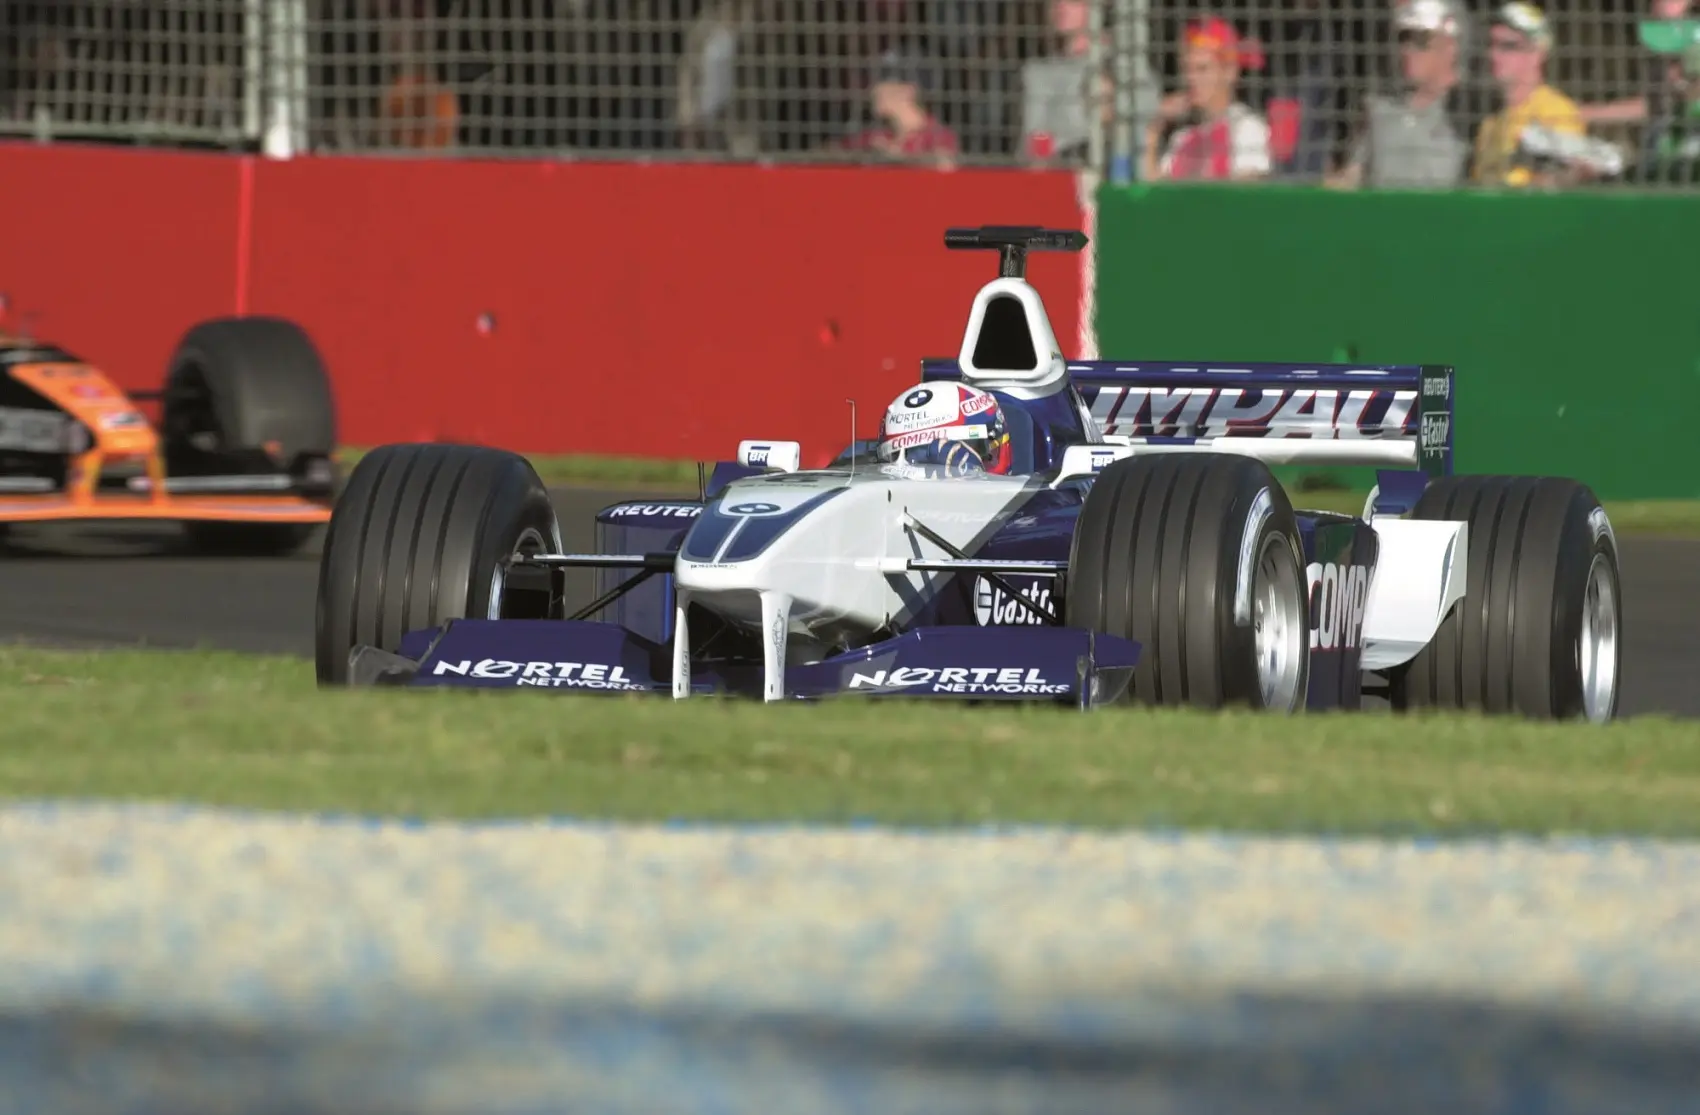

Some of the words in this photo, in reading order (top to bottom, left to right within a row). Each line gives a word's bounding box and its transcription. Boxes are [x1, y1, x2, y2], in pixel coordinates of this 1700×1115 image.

[889, 411, 929, 425] NORTEL
[993, 581, 1057, 625] Castr
[1306, 562, 1374, 649] COMP
[433, 658, 631, 683] NORTEL
[849, 666, 1046, 688] NORTEL
[932, 683, 1070, 694] NETWORKS
